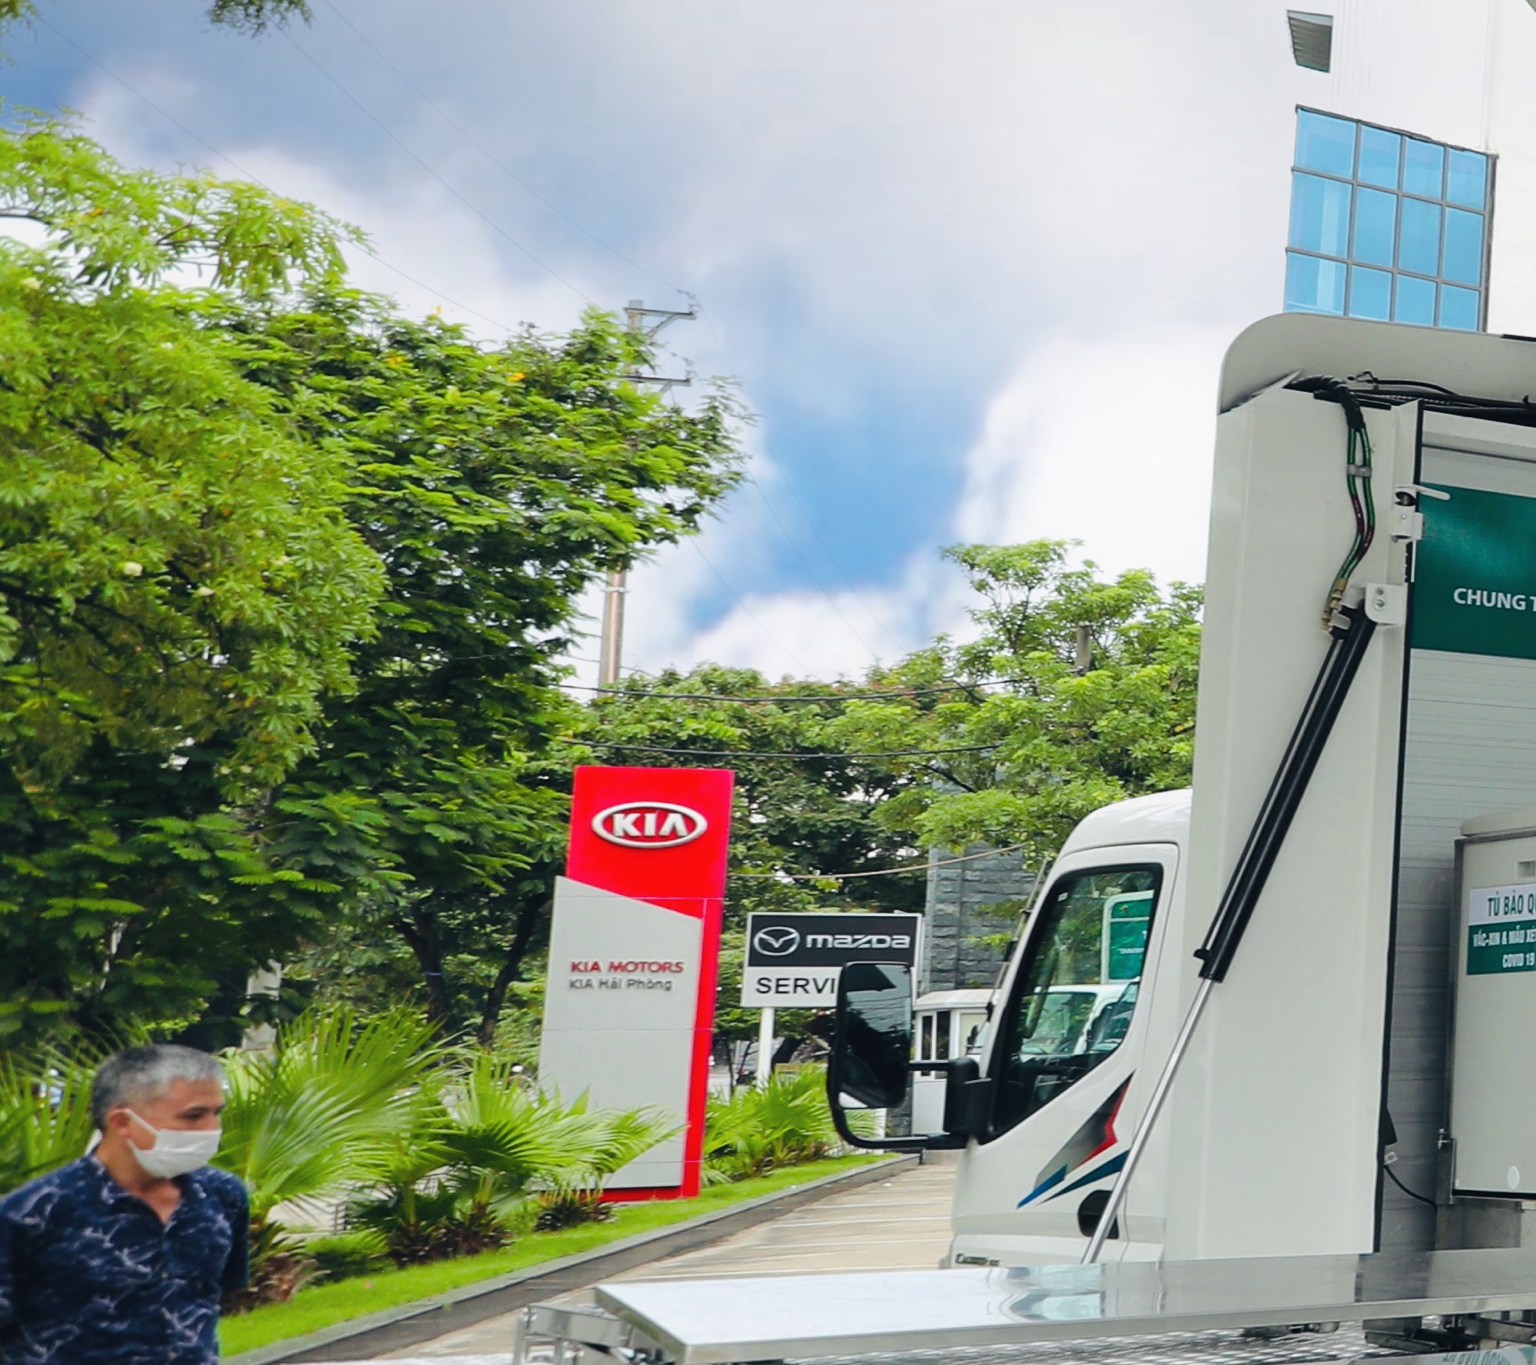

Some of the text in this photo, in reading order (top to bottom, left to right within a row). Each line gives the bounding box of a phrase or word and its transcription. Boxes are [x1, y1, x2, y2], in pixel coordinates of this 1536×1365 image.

[1453, 588, 1526, 611] CHUNG
[612, 812, 685, 838] KIA
[1487, 891, 1500, 917] TỦ
[1503, 889, 1524, 916] BẢO
[805, 934, 911, 949] mazda
[570, 961, 684, 973] KIA MOTORS
[569, 978, 596, 990] KIA
[627, 978, 672, 992] Phòng
[756, 976, 836, 995] SERVI
